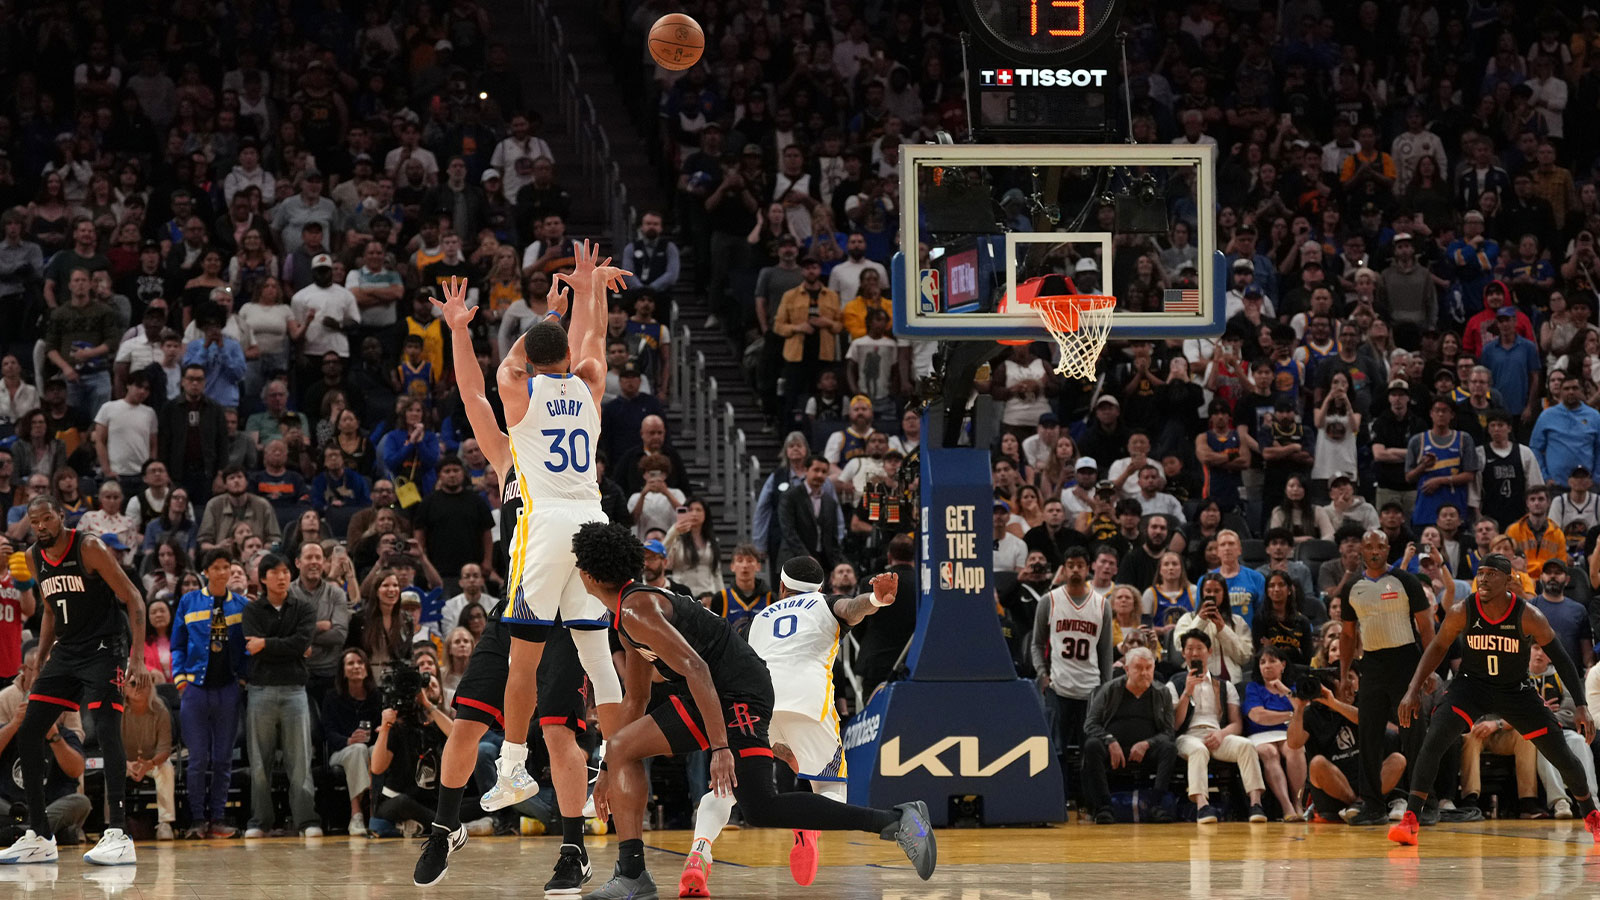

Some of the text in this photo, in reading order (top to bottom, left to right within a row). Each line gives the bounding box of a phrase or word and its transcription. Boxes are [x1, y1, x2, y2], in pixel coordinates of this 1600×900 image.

[1015, 69, 1107, 87] TISSOT
[546, 398, 584, 418] CURRY
[541, 428, 590, 473] 30
[945, 505, 976, 532] GET
[946, 533, 977, 560] THE
[41, 575, 86, 600] HOUSTON
[954, 562, 985, 594] App
[57, 599, 69, 625] 7
[762, 598, 805, 619] PAYTON
[773, 614, 798, 639] 0
[1056, 618, 1098, 637] DAVIDSON
[1062, 637, 1090, 661] 30
[1466, 634, 1519, 653] HOUSTON
[1486, 654, 1499, 676] 0
[880, 735, 1049, 777] KIA
